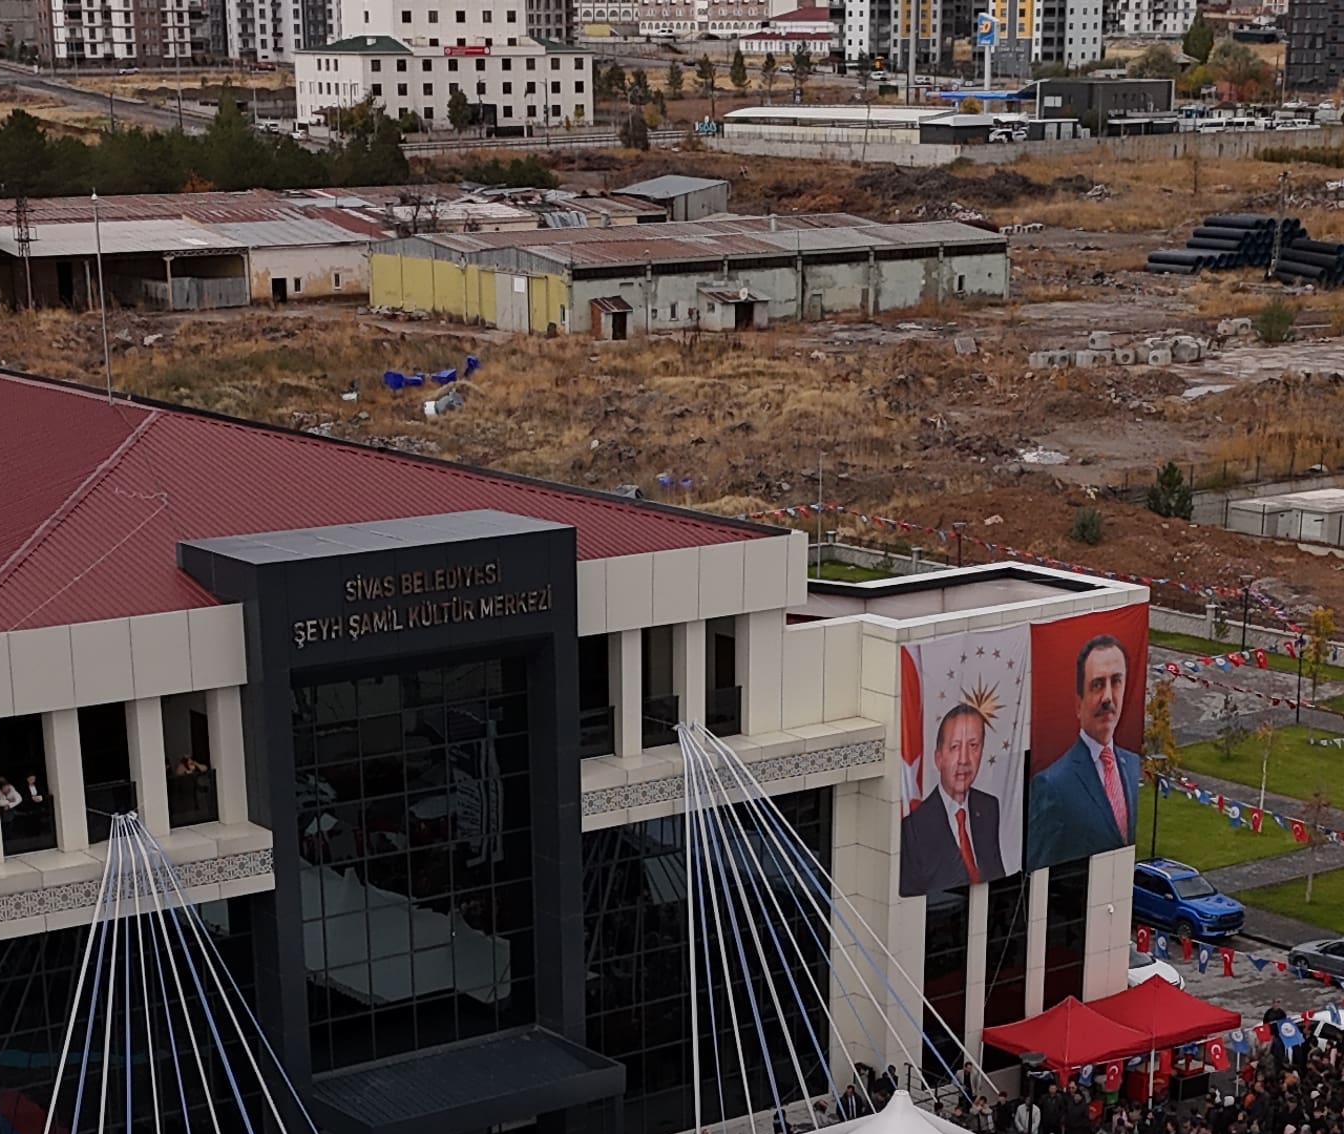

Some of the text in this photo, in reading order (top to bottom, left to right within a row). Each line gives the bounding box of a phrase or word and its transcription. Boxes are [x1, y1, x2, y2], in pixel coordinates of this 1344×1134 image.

[345, 558, 501, 602] SİVAS BELEDİYESİ
[293, 584, 552, 649] ŞEYH ŞAMİL KÜLTÜR MERKEZİ
